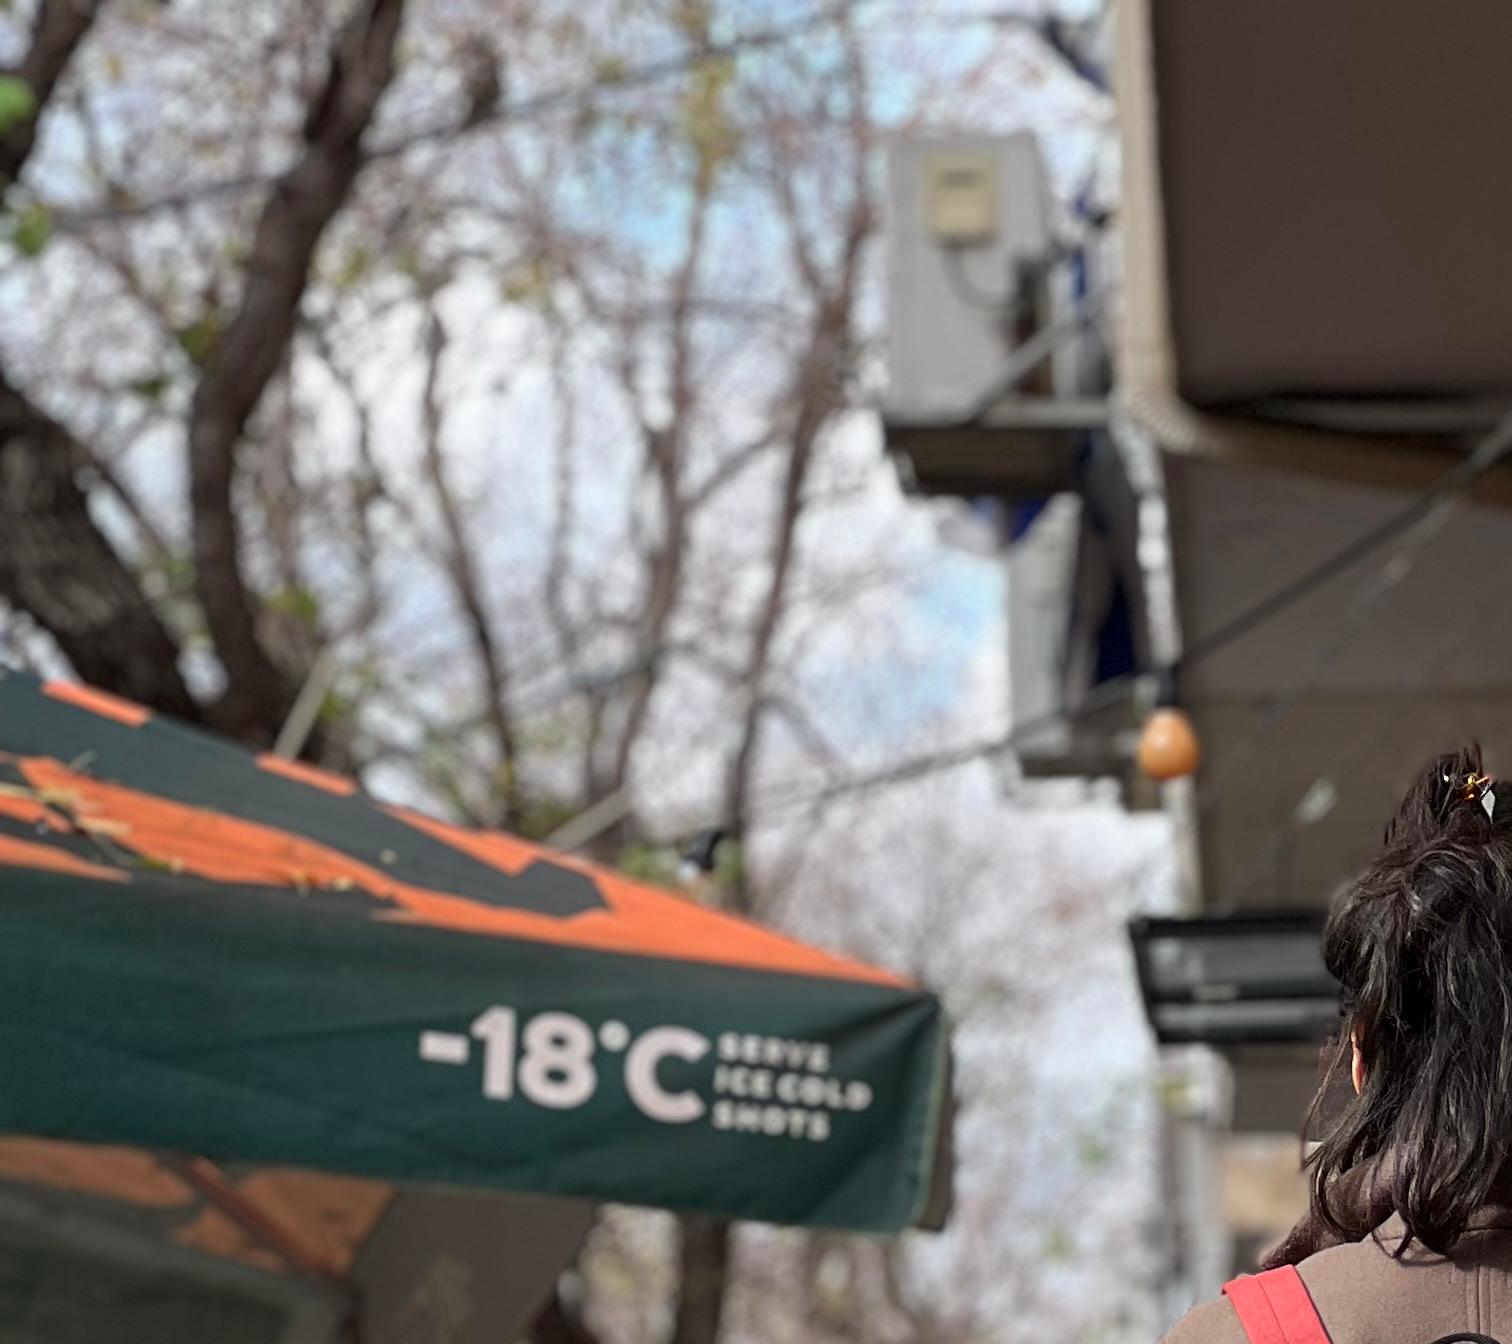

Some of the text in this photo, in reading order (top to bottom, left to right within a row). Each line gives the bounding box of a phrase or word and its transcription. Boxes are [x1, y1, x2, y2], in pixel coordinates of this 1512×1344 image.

[419, 1006, 708, 1123] -18°C
[717, 1032, 831, 1073] SERVE
[713, 1064, 873, 1112] ICE COLD
[712, 1099, 831, 1142] SHOTS
